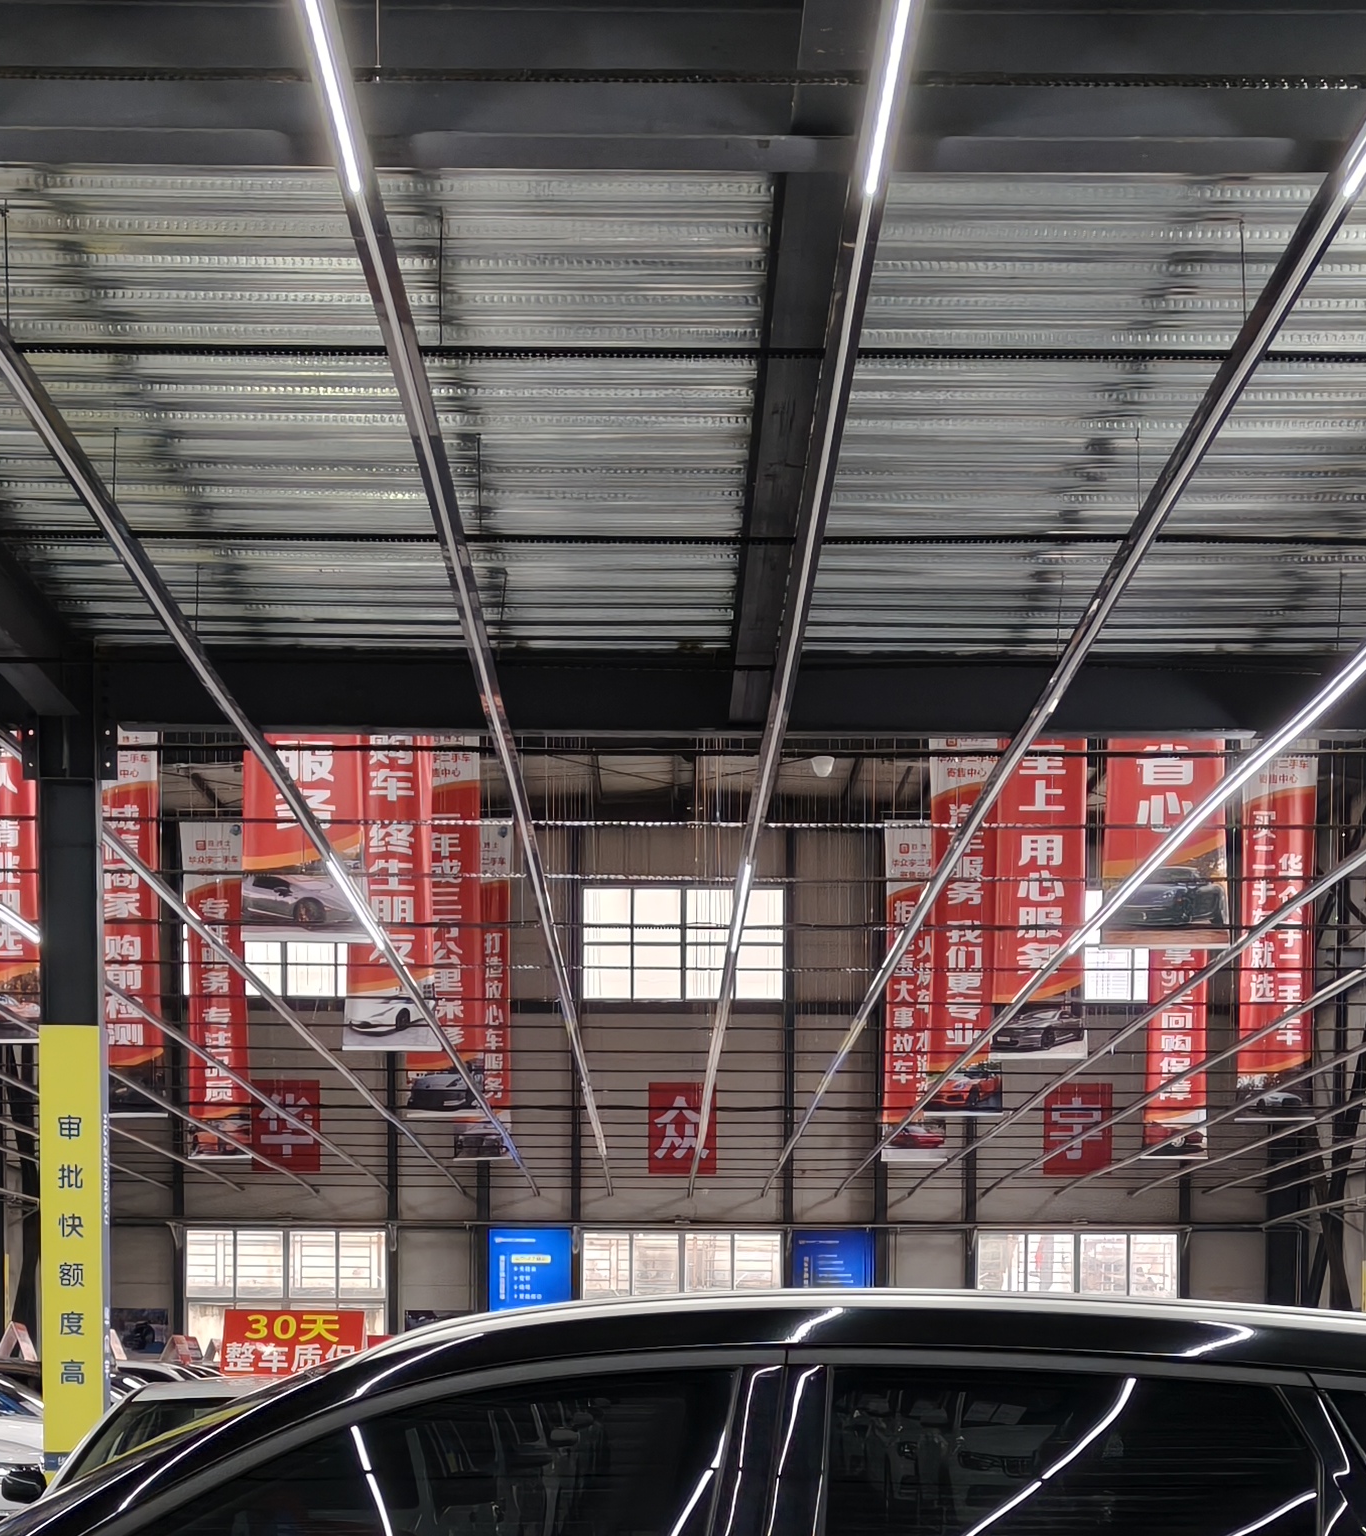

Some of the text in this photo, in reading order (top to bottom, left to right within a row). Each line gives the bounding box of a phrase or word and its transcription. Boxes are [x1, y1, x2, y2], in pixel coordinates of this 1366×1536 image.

[275, 740, 336, 830] 服务
[1137, 744, 1194, 832] 省心
[369, 735, 415, 963] 购车 终生朋友
[1017, 745, 1067, 974] 至上 用心服务
[105, 935, 144, 1045] 购前检测
[945, 920, 984, 1046] 我们更专业
[653, 1096, 710, 1159] 众
[1050, 1097, 1103, 1159] 宇
[57, 1114, 86, 1386] 审批快额度高
[244, 1314, 340, 1343] 30天
